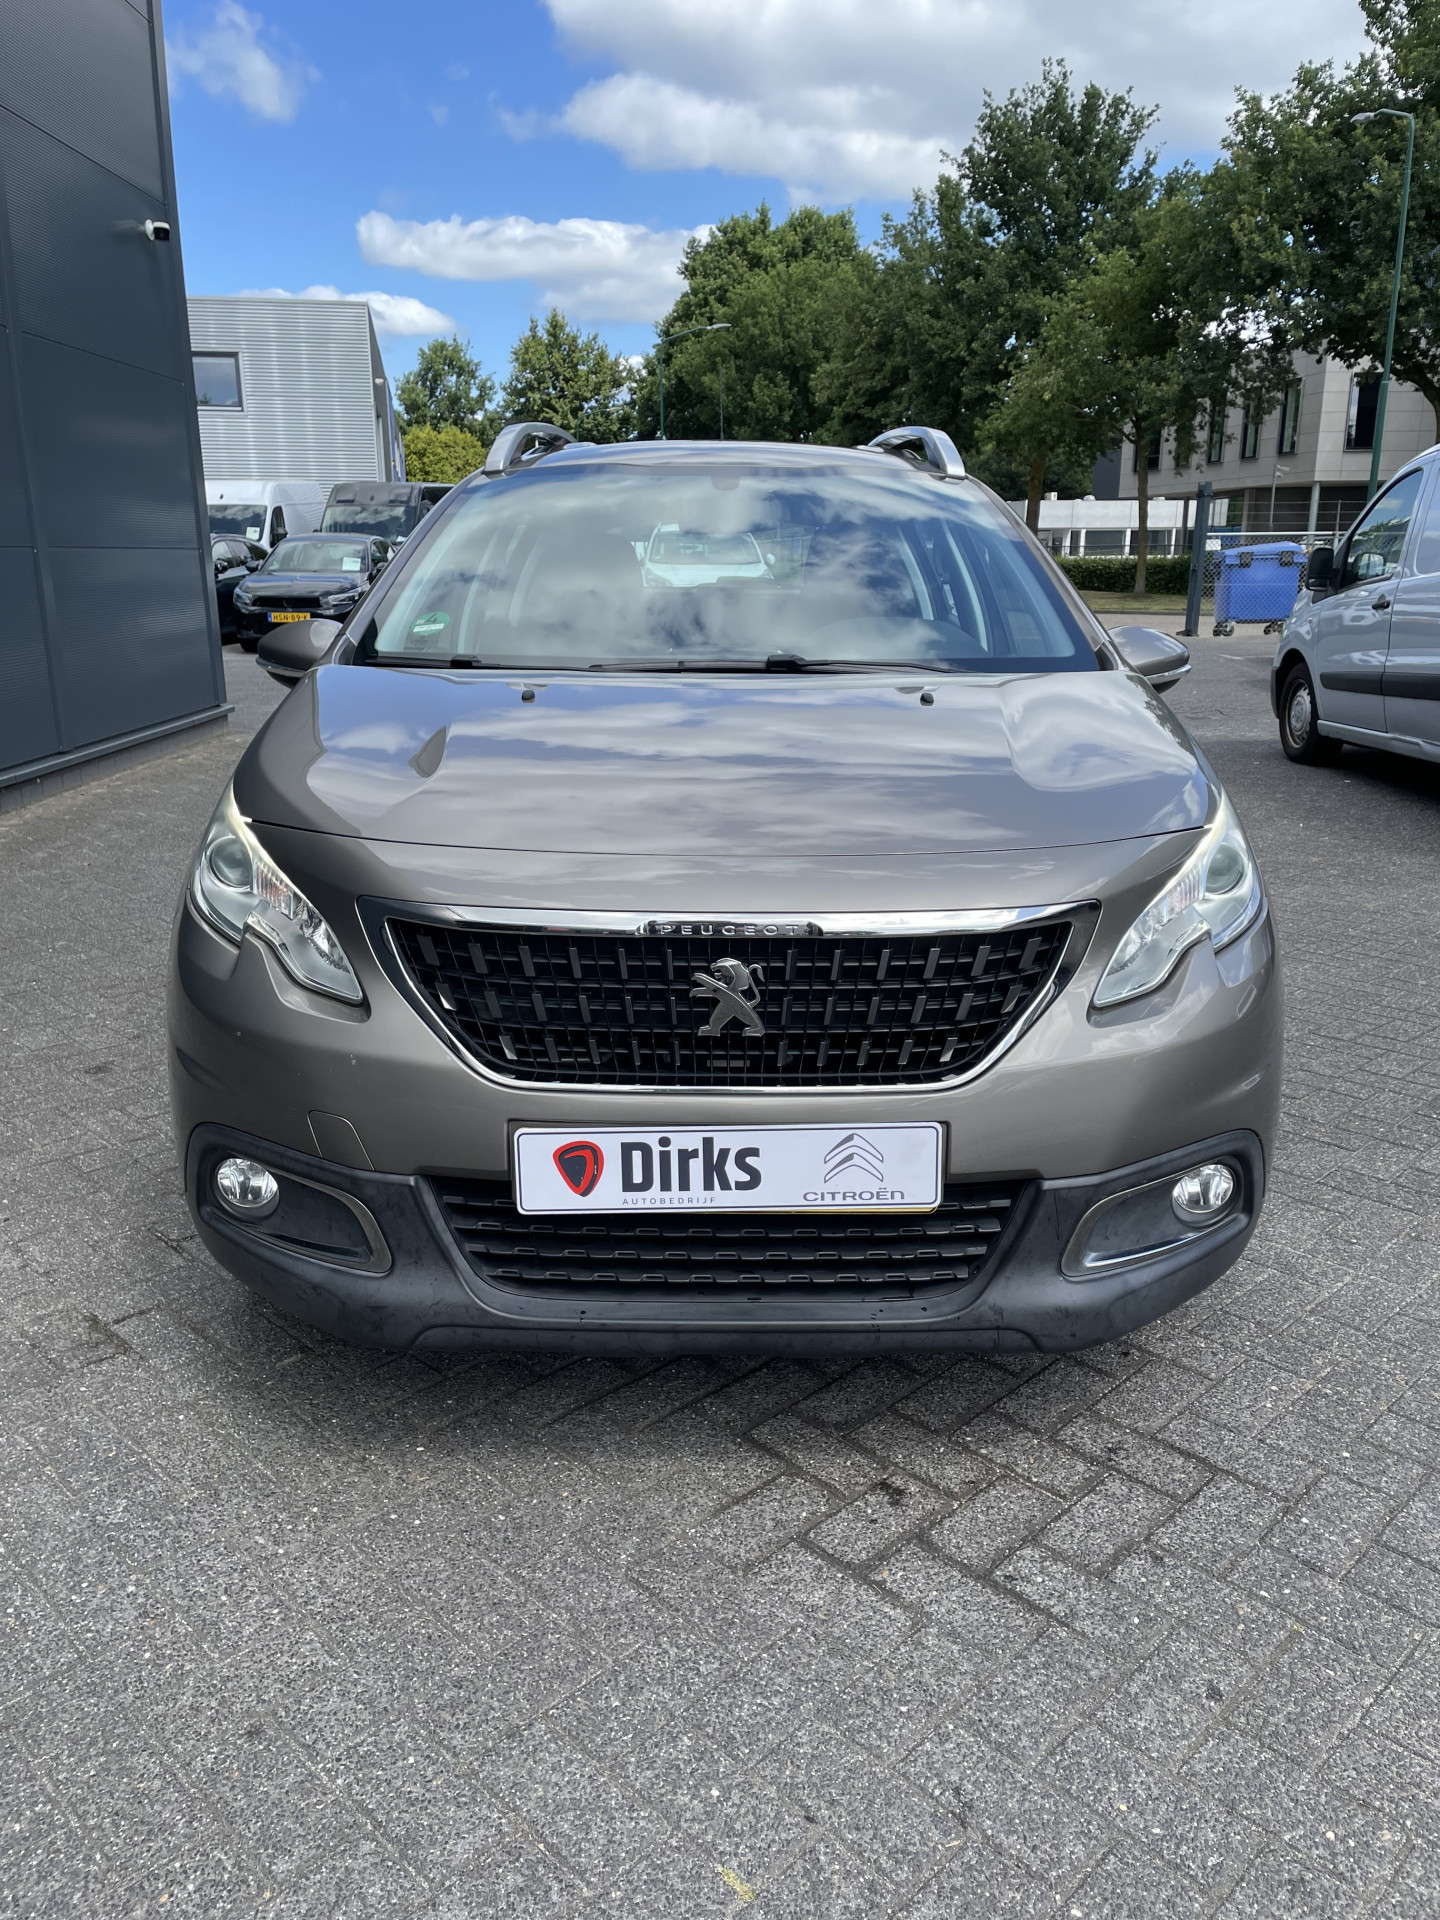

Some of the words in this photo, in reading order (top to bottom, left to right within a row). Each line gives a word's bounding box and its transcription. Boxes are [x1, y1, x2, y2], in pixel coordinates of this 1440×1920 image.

[426, 612, 438, 623] 4
[659, 923, 800, 936] PEUGEOT
[620, 1136, 762, 1192] Dirks
[622, 1196, 716, 1206] AUTOBEDRIJF
